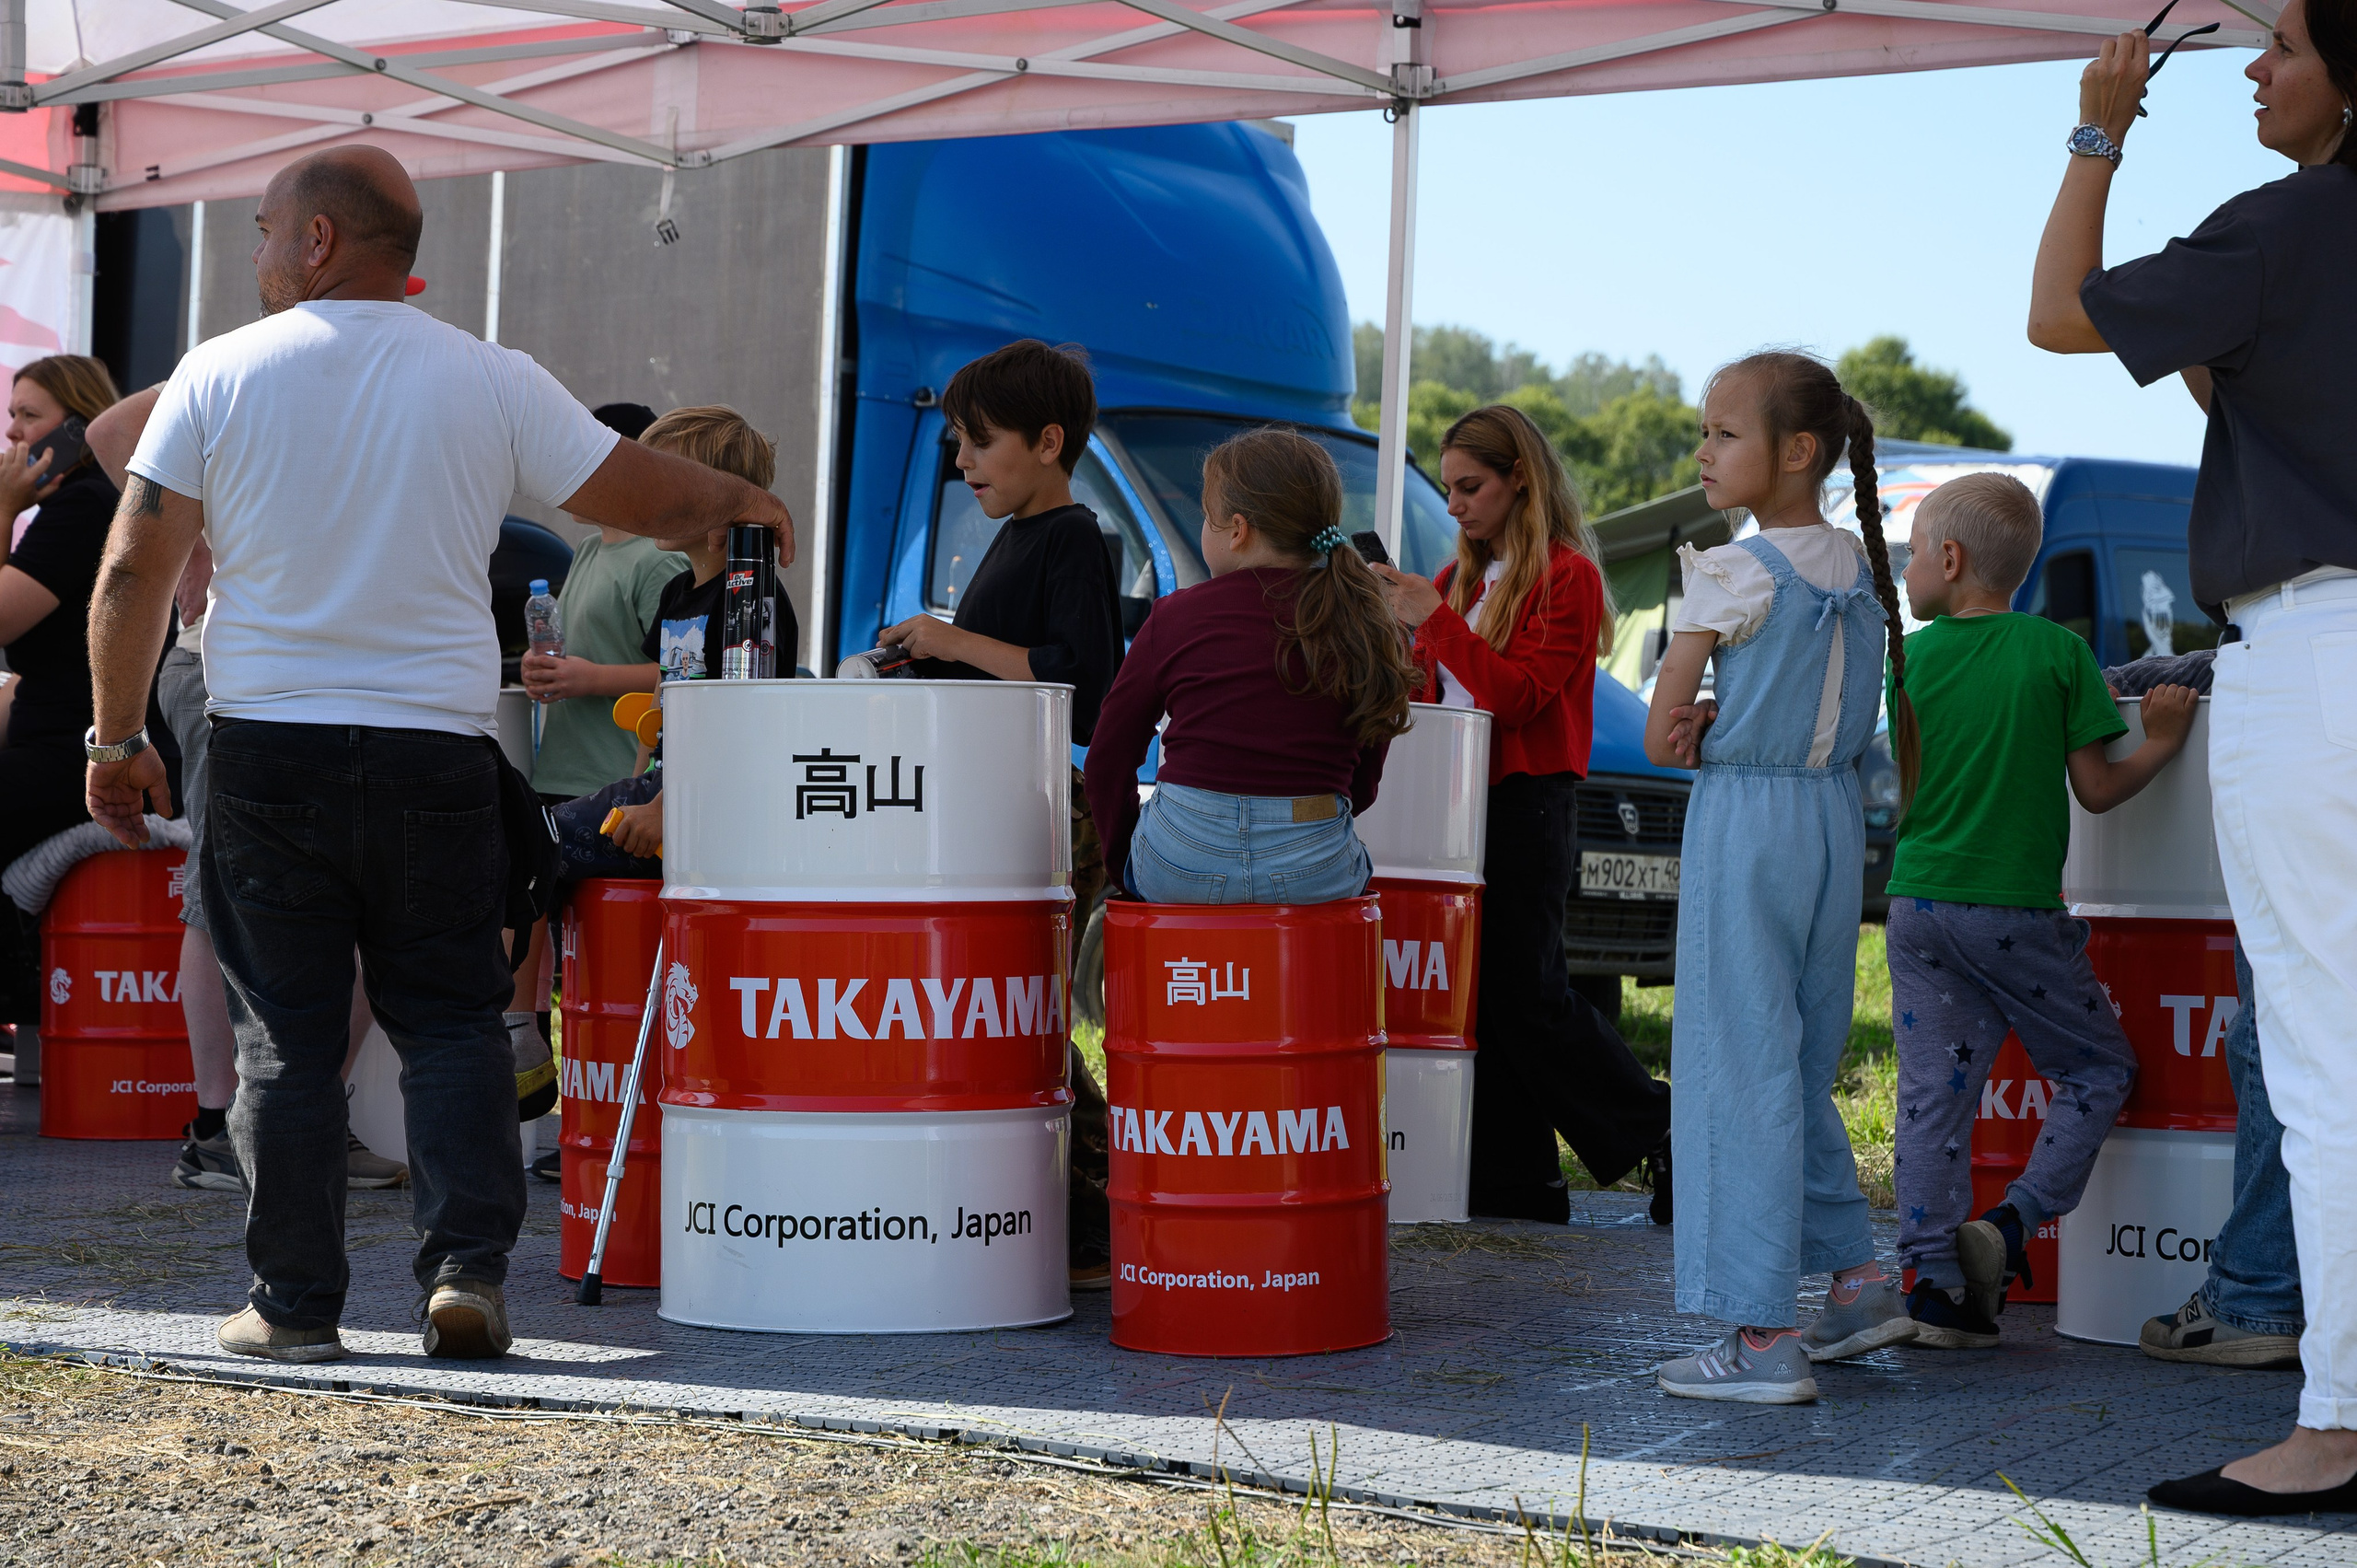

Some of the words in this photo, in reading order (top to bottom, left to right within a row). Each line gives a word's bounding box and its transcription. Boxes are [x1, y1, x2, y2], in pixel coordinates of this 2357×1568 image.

[726, 578, 753, 587] Active
[792, 747, 925, 820] 高山
[1164, 957, 1250, 1006] 高山
[1383, 938, 1450, 991] MA
[729, 974, 1065, 1040] TAKAYAMA
[110, 1079, 134, 1094] JCI
[1110, 1105, 1351, 1156] TAKAYAMA
[685, 1200, 716, 1236] JCI
[723, 1203, 938, 1249] Corporation,
[951, 1206, 1032, 1248] Japan
[2106, 1223, 2146, 1259] JCI
[1120, 1262, 1136, 1283] JCI
[1138, 1266, 1255, 1292] Corporation,
[1261, 1270, 1320, 1293] Japan
